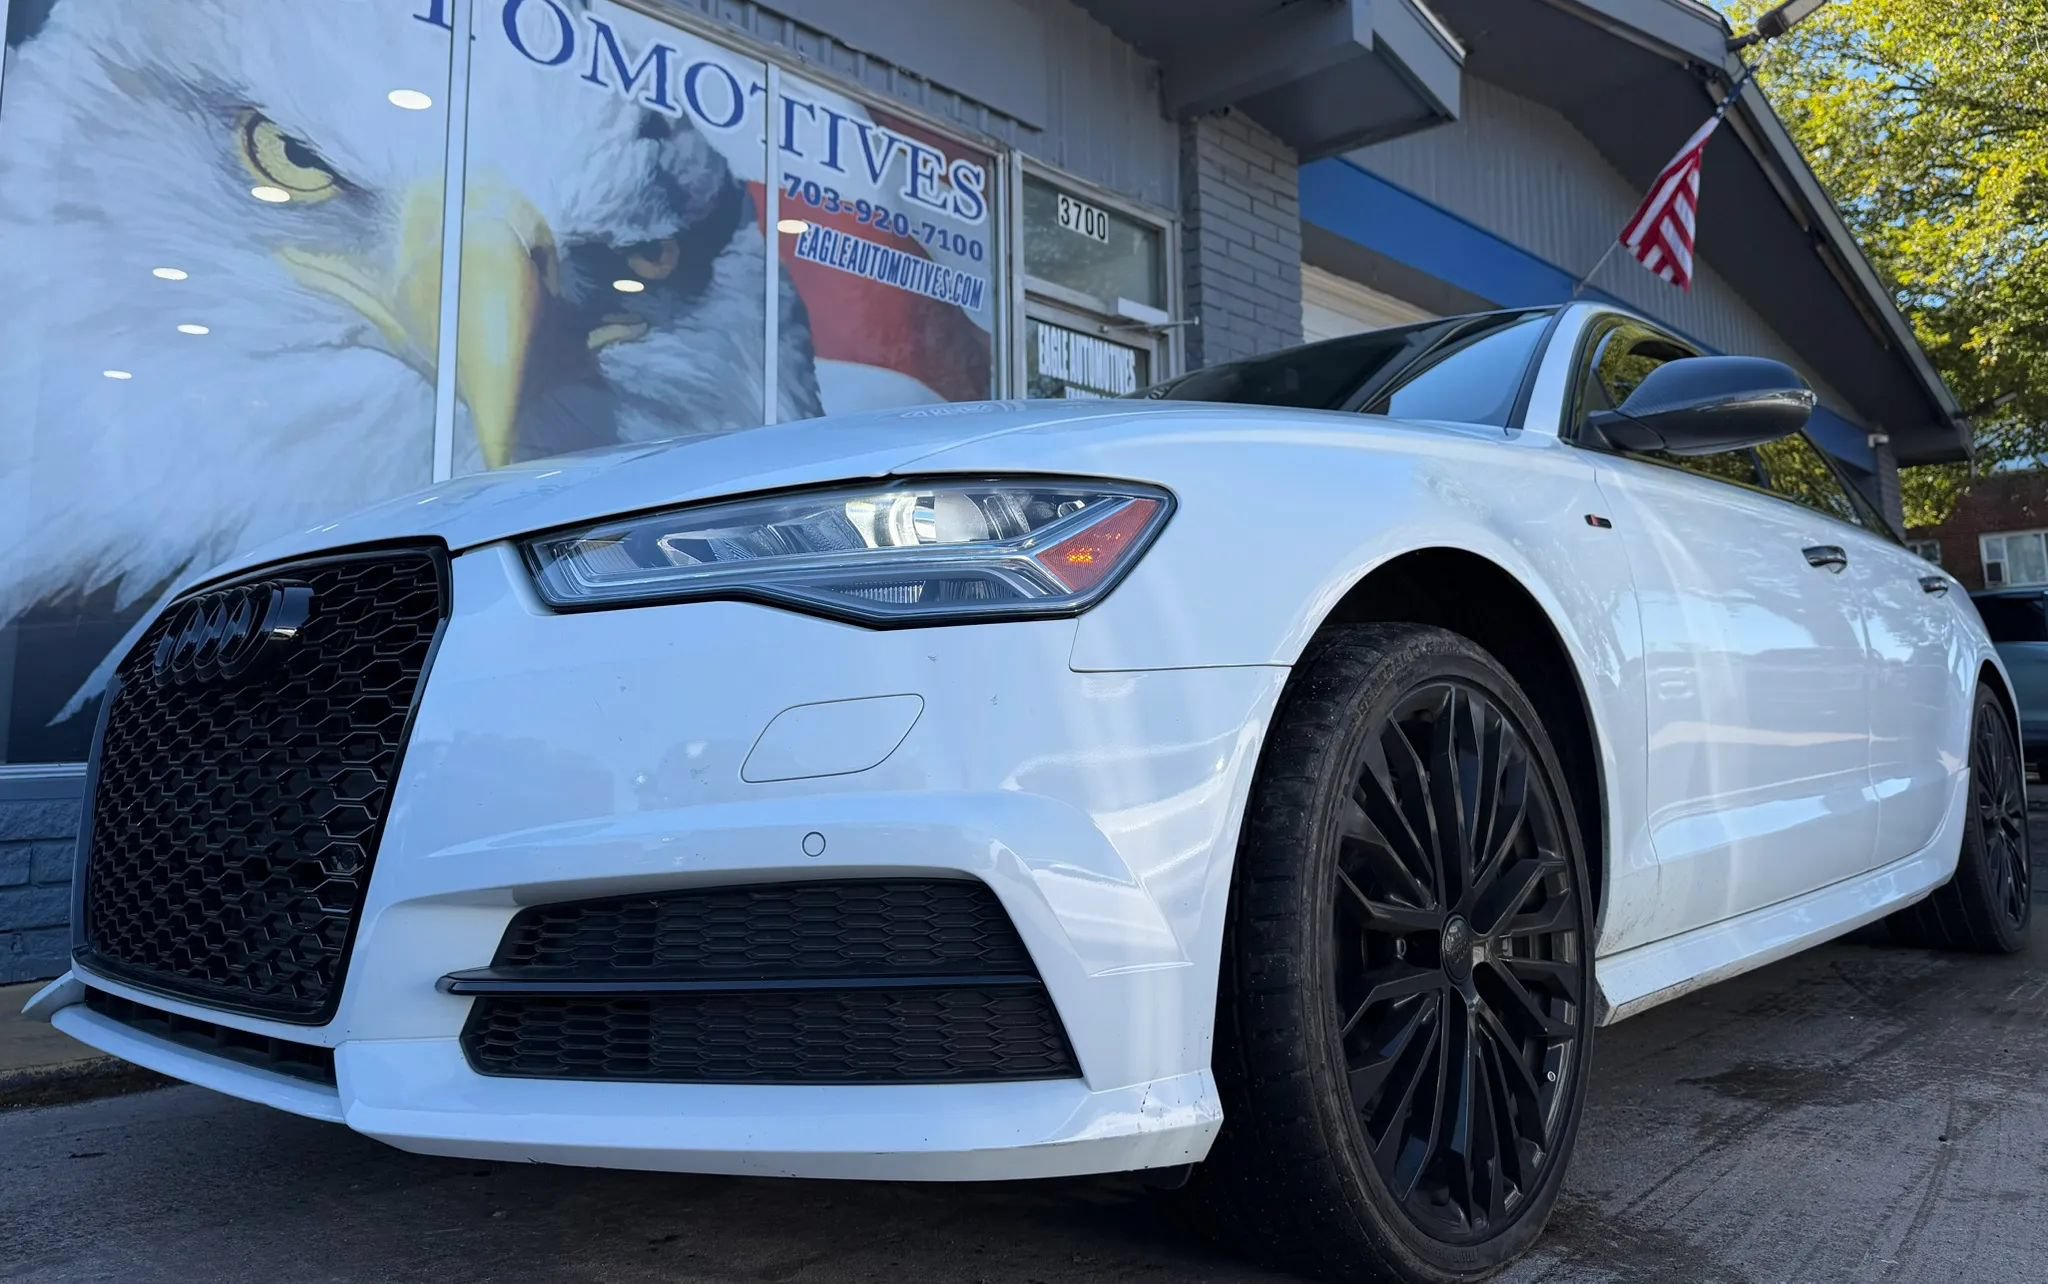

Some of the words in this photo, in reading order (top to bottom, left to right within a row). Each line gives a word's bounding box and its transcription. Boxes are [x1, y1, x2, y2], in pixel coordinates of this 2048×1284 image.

[784, 172, 983, 262] 703-920-7100
[1061, 197, 1106, 240] 3700
[797, 223, 984, 309] EAGLEAUTOMOTIVES.COM
